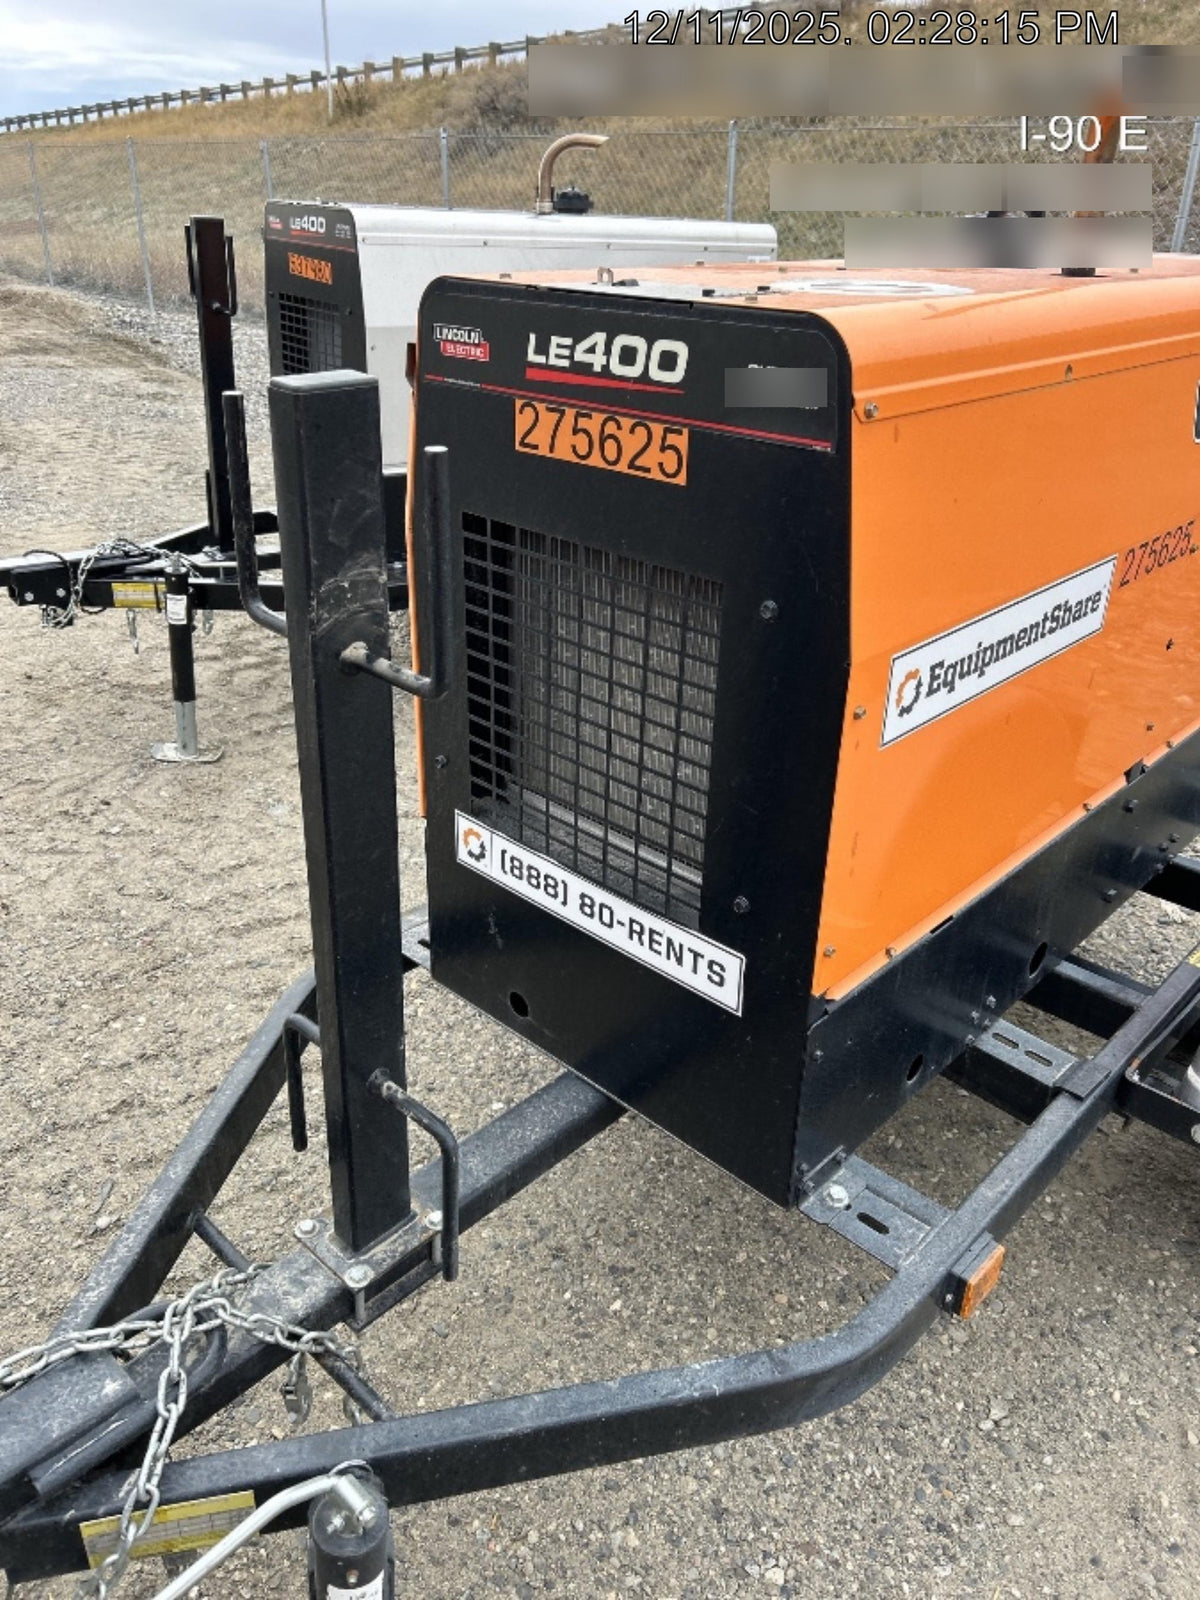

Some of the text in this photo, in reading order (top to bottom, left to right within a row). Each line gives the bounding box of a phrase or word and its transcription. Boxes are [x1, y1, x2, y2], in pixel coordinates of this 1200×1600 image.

[436, 326, 479, 344] LINCOLN
[446, 343, 485, 357] ELECTRIC
[527, 332, 689, 384] LE400
[517, 401, 686, 480] 275625
[1119, 519, 1195, 589] 275625
[925, 590, 1102, 698] EquipmentShare
[501, 849, 726, 988] (888) 80-RENTS
